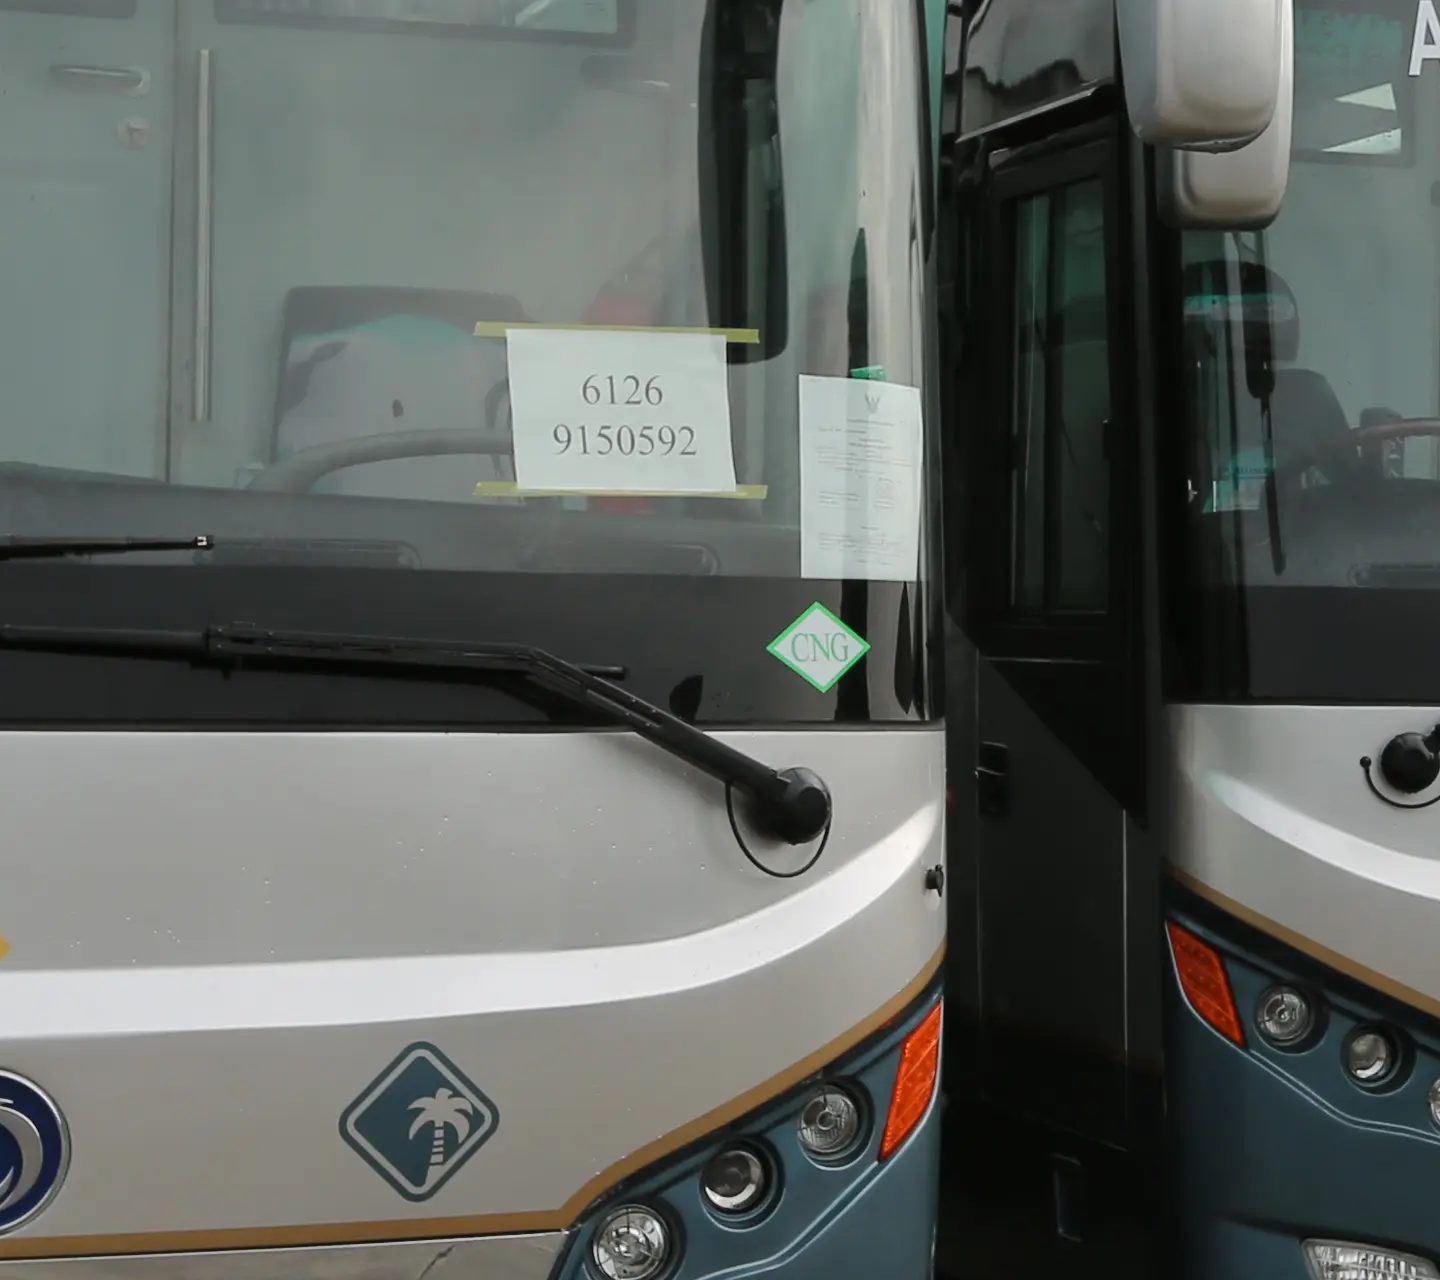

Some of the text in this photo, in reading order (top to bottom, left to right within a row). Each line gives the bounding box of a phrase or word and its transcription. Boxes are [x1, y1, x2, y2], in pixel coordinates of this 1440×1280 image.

[582, 374, 663, 406] 6126
[552, 424, 698, 457] 9150592
[790, 631, 850, 663] CNG
